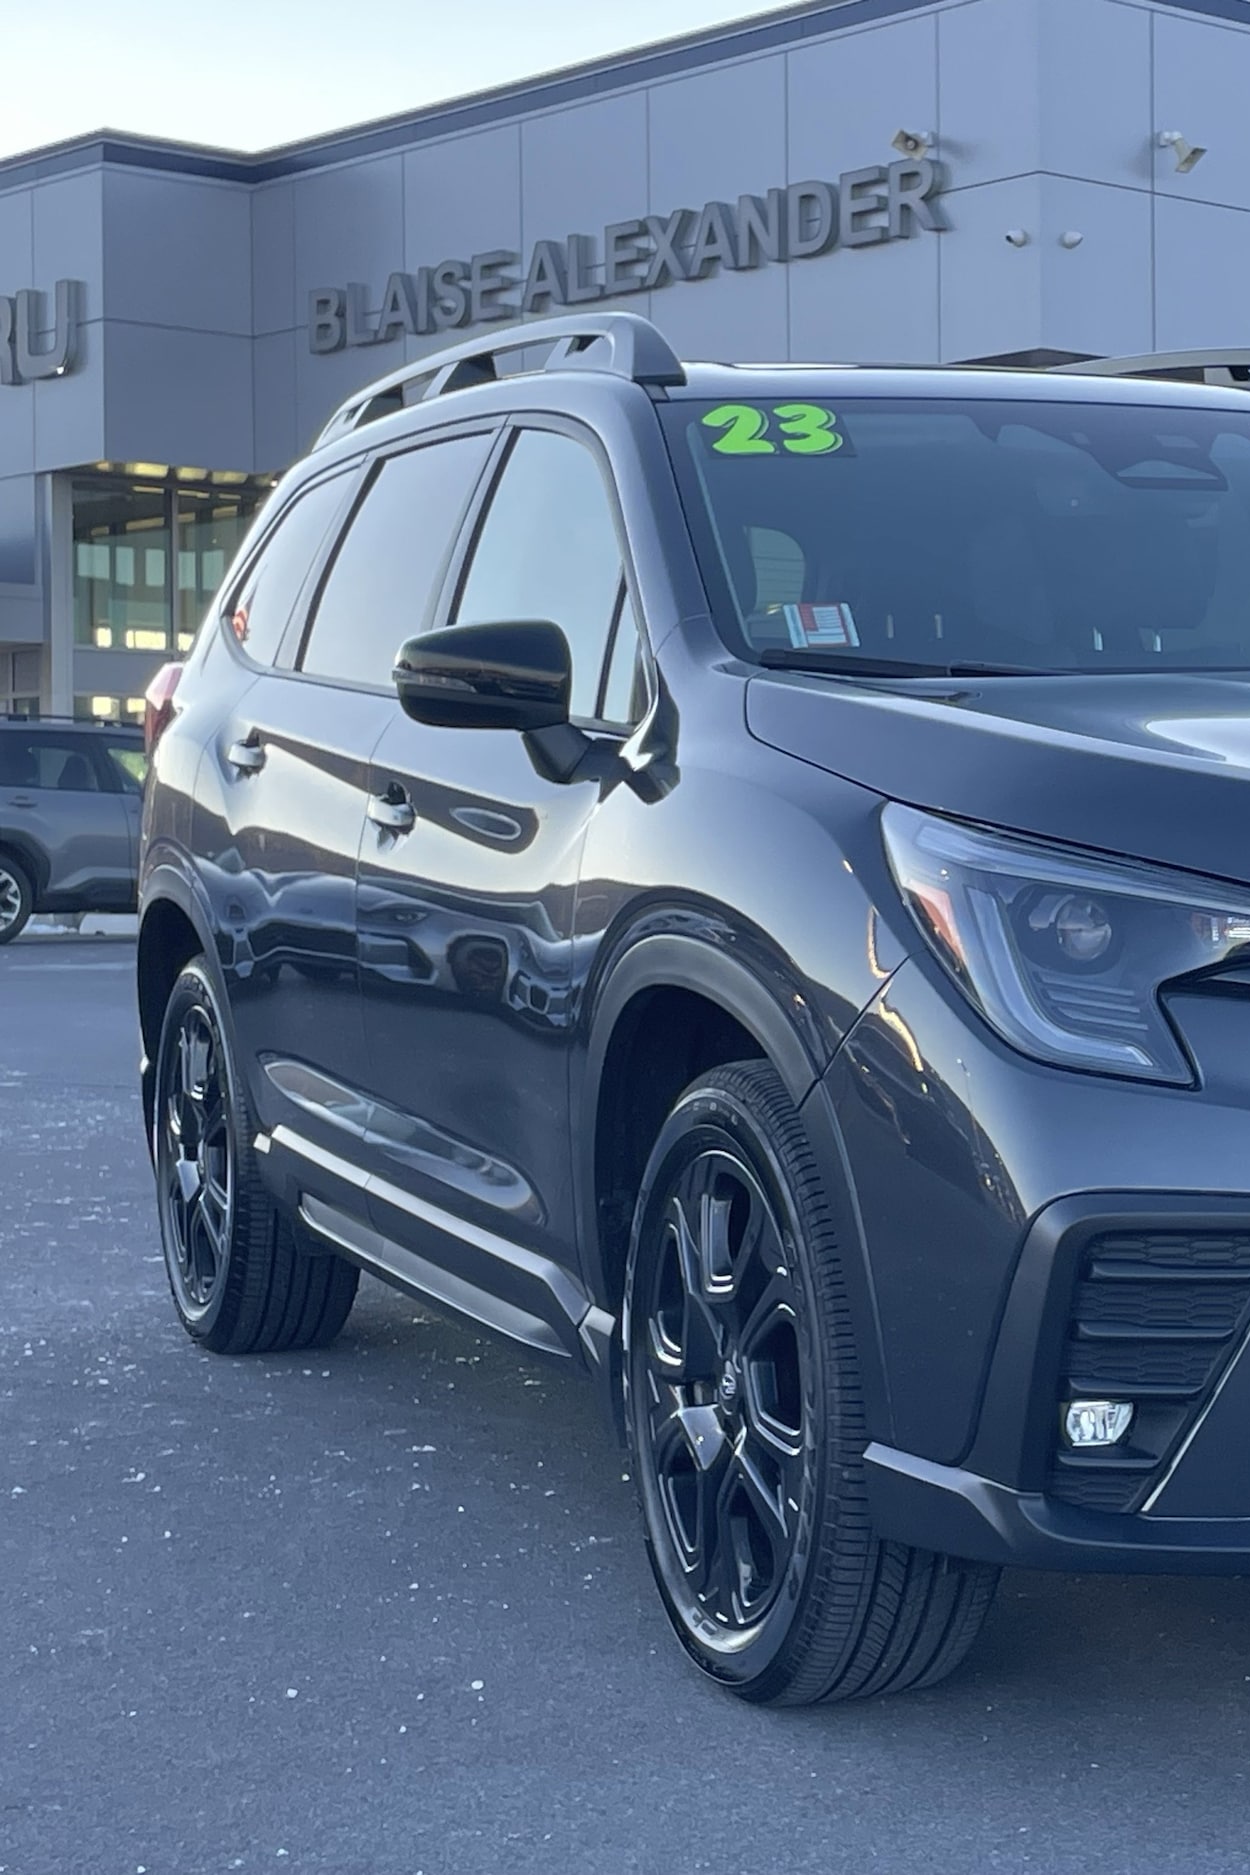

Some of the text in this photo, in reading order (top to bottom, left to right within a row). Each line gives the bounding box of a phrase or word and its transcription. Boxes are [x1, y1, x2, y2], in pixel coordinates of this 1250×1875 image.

[308, 158, 952, 354] BLAISE ALEXANDER
[702, 404, 843, 454] 23
